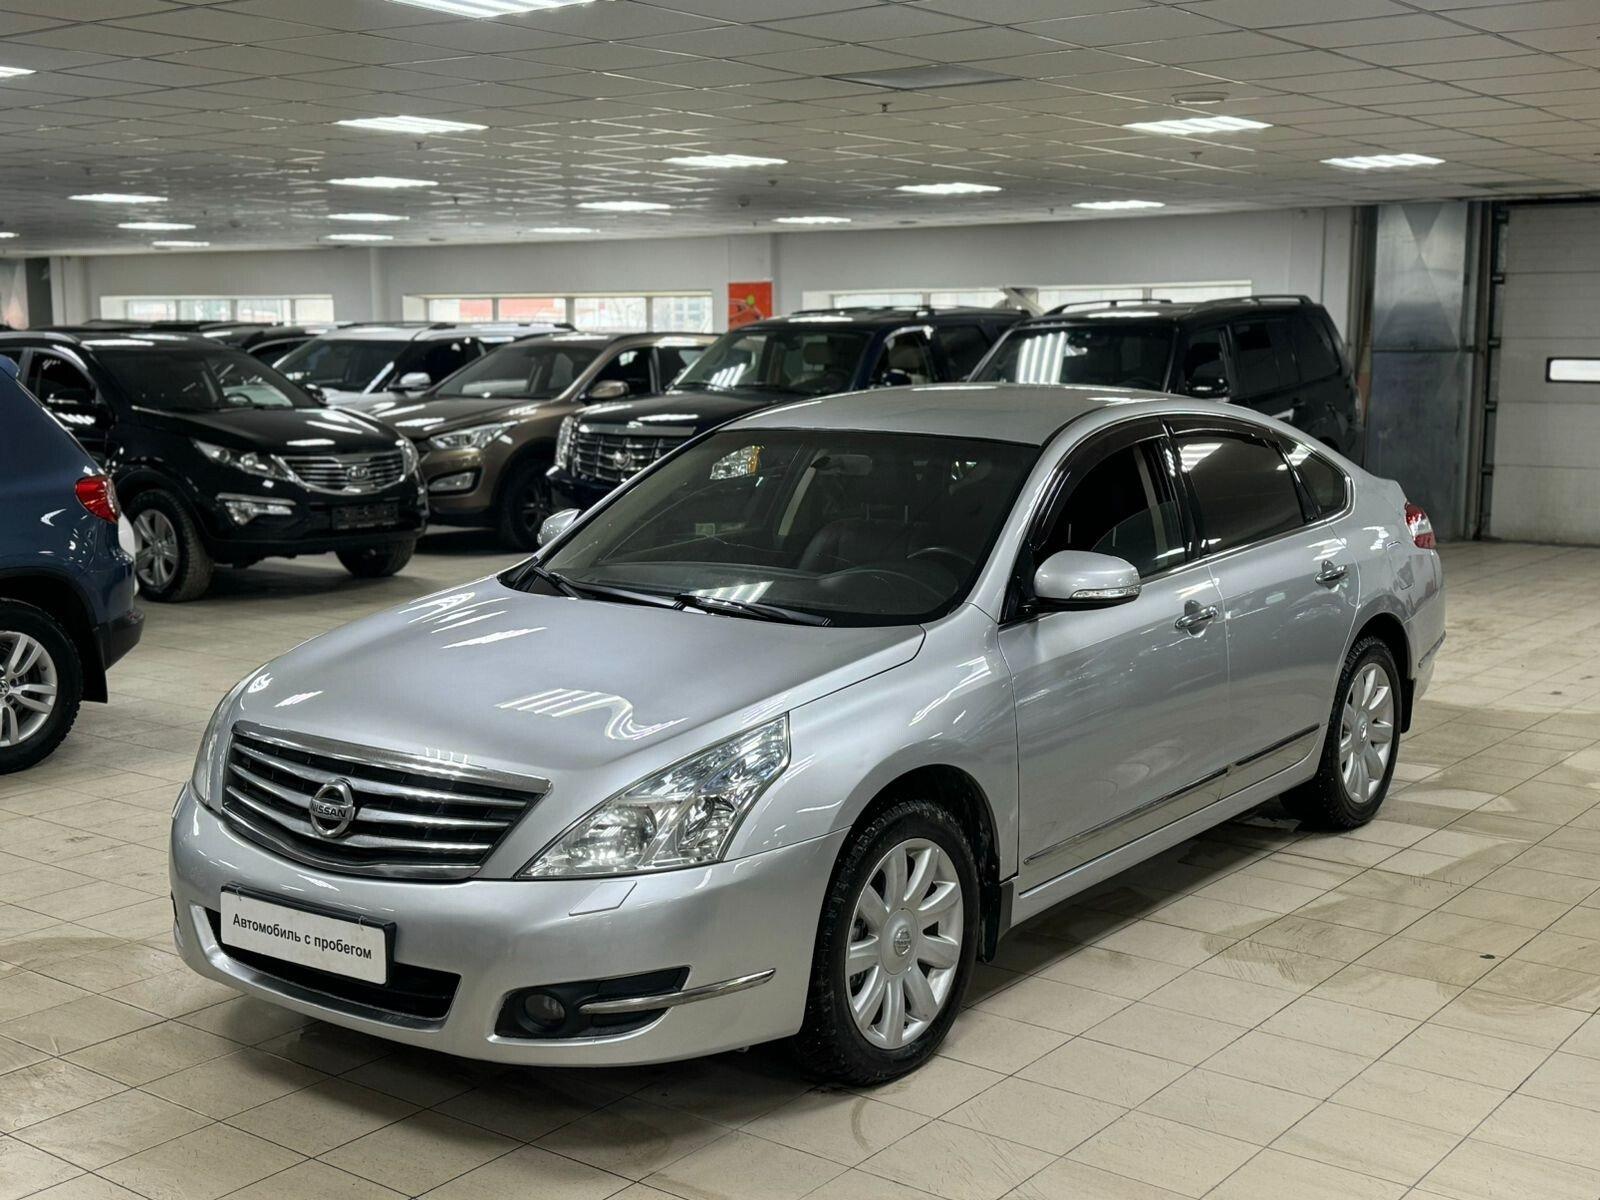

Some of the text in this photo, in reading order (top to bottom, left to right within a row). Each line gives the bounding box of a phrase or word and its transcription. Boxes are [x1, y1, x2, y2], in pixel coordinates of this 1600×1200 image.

[311, 803, 347, 818] NISSAN
[232, 913, 372, 959] Автомобиль с пробегом
